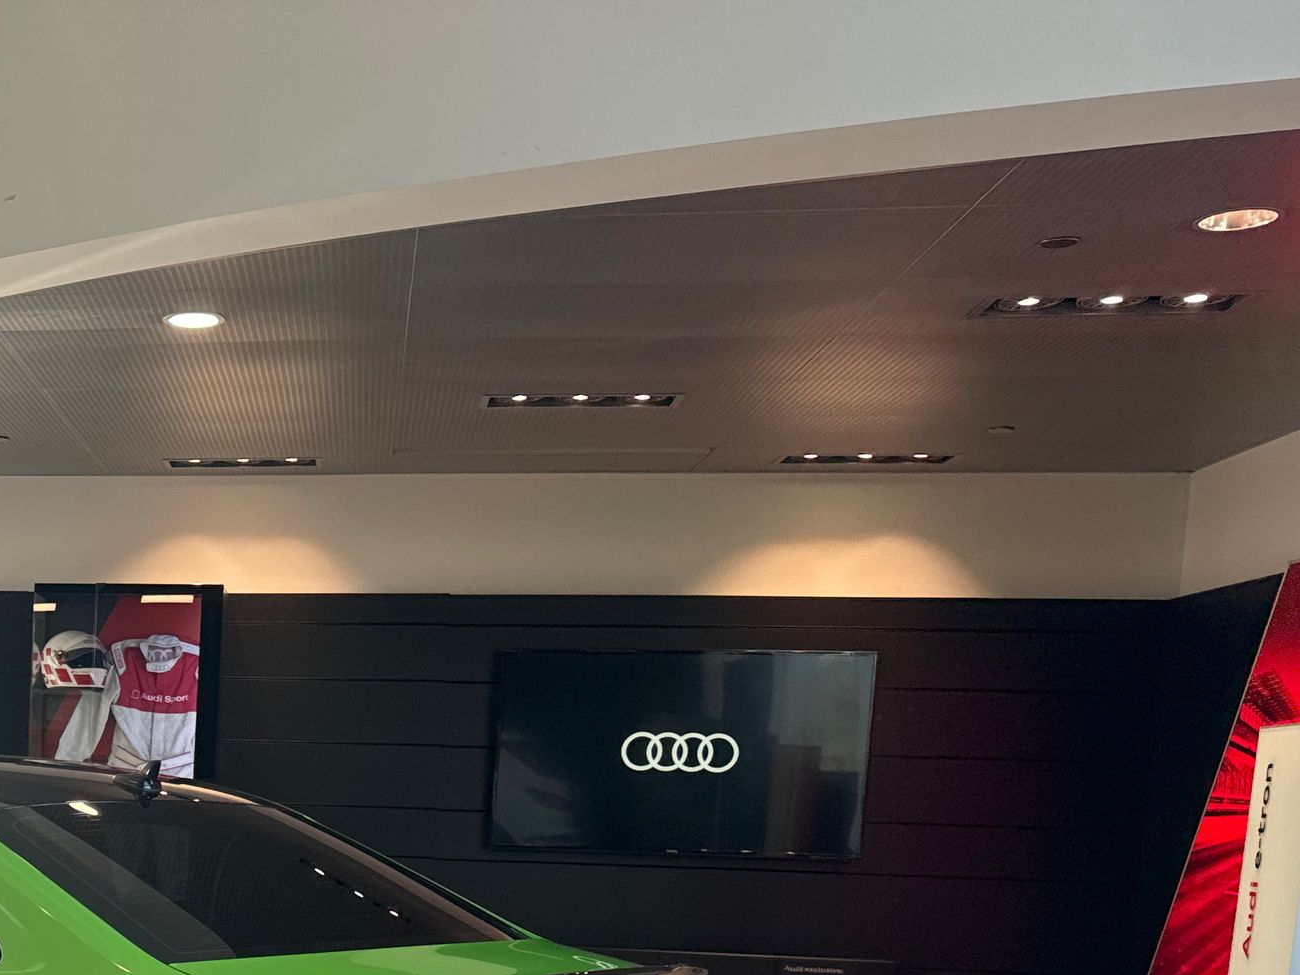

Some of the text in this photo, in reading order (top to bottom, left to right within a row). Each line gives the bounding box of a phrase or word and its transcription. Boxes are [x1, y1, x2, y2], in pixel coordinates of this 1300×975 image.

[141, 692, 189, 703] Audi Sport
[1242, 762, 1274, 960] Audi e-tron
[783, 964, 845, 974] Audi exclusive
